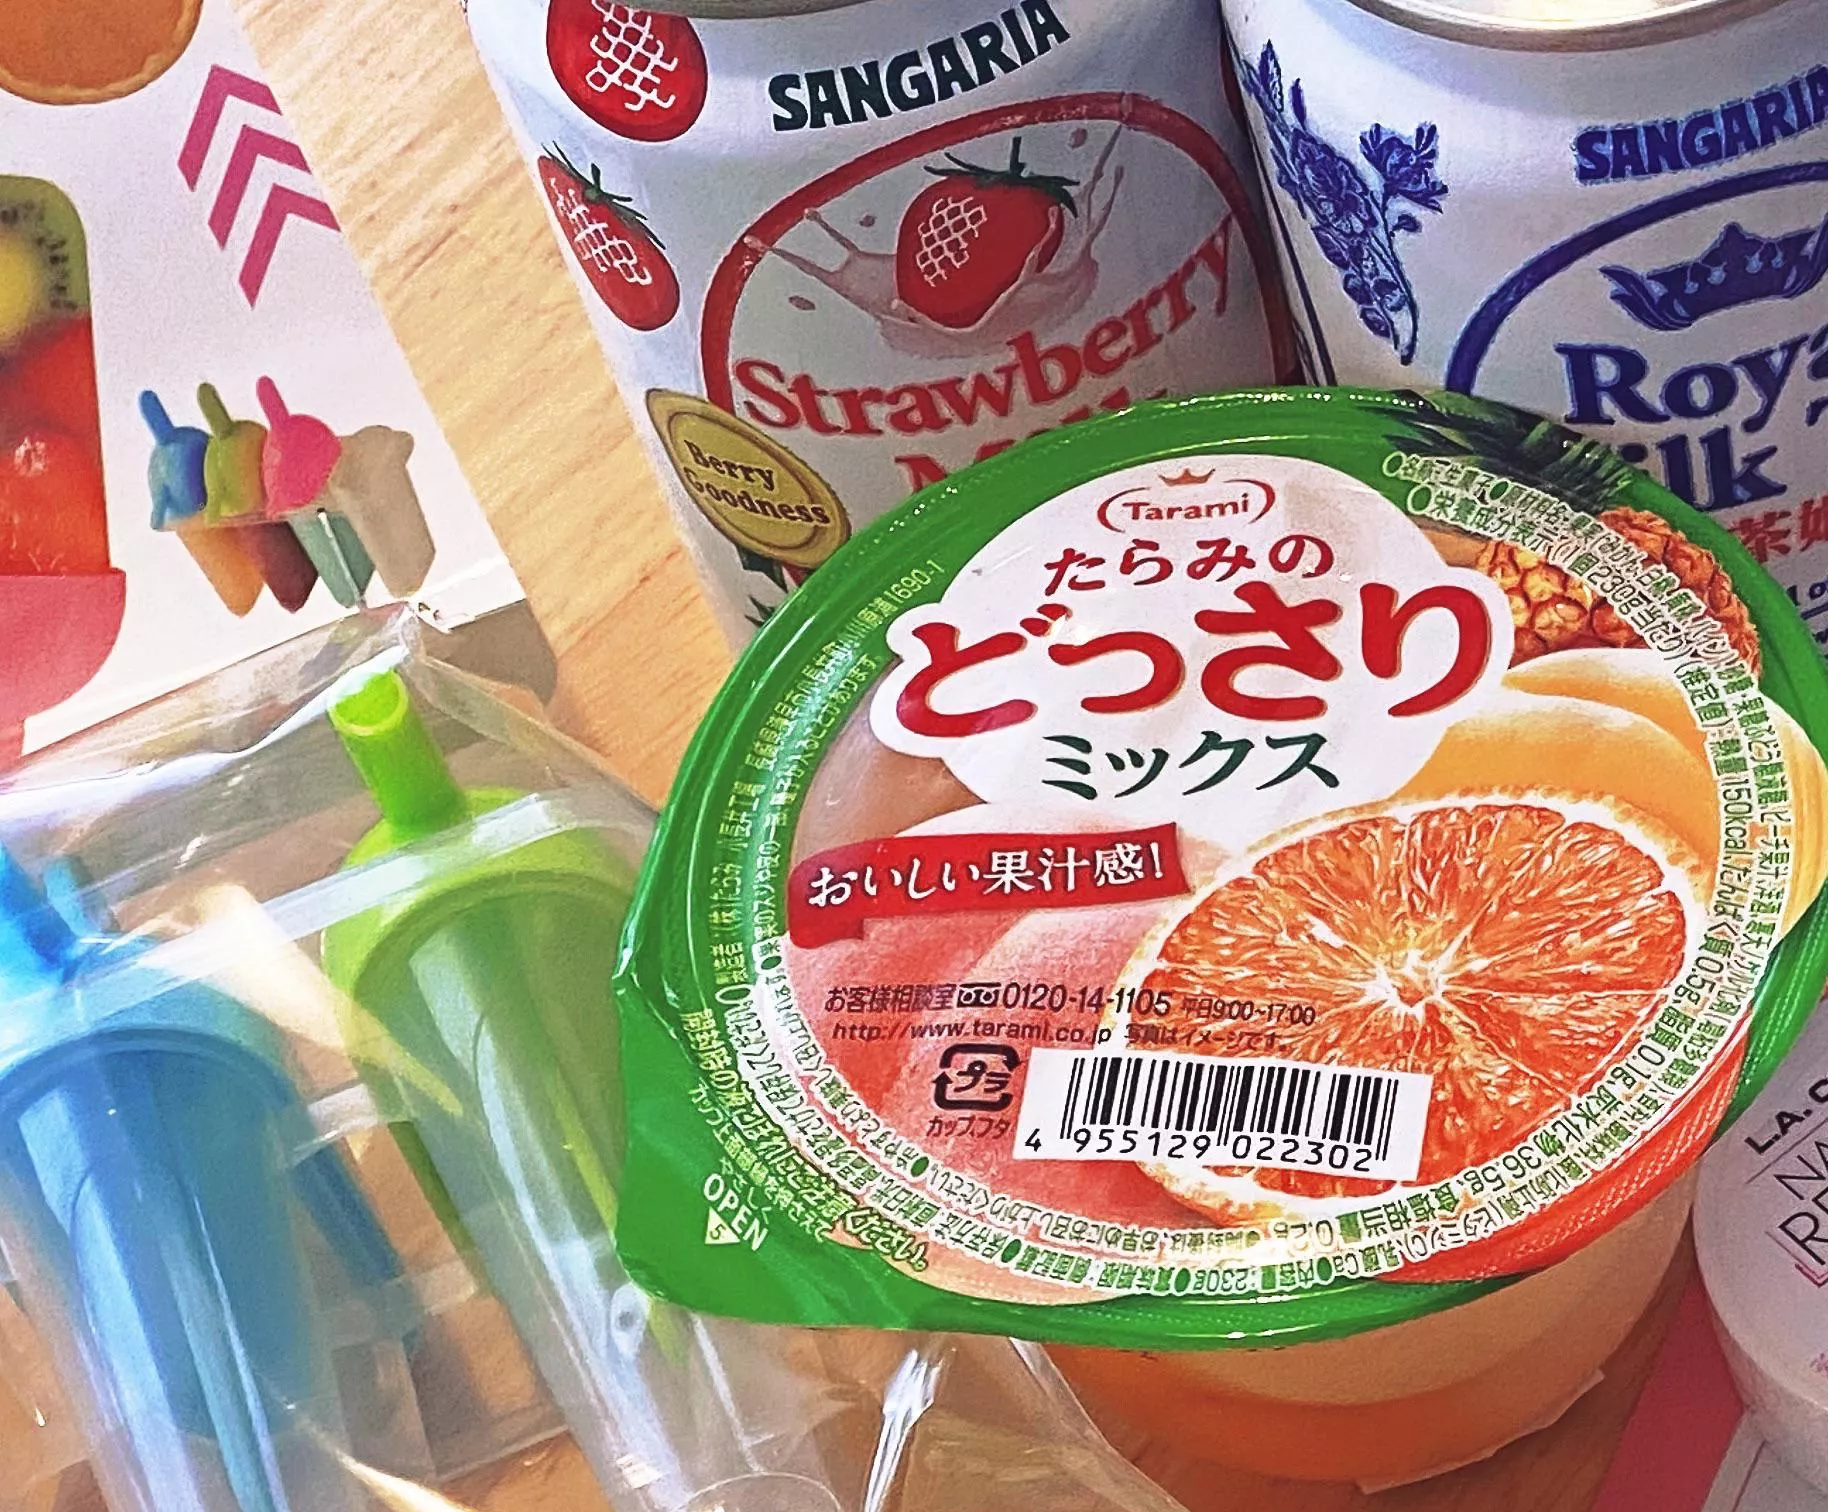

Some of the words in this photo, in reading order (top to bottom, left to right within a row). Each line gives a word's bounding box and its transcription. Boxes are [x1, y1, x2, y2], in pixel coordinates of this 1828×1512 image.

[768, 0, 1070, 132] SANGARIA
[733, 212, 1236, 438] Strawberry
[683, 466, 832, 530] Goodness
[684, 438, 778, 494] Berry
[1121, 492, 1250, 522] Tarami
[1044, 533, 1335, 597] たらみの
[896, 580, 1491, 738] どっさり
[1042, 730, 1341, 802] ミックス
[1002, 981, 1174, 1018] 0120-14-1105
[1024, 1127, 1042, 1152] 4
[1072, 1128, 1211, 1162] 955129
[1230, 1135, 1373, 1173] 022302
[1744, 1105, 1814, 1157] L.A.
[703, 1173, 769, 1252] OPEN
